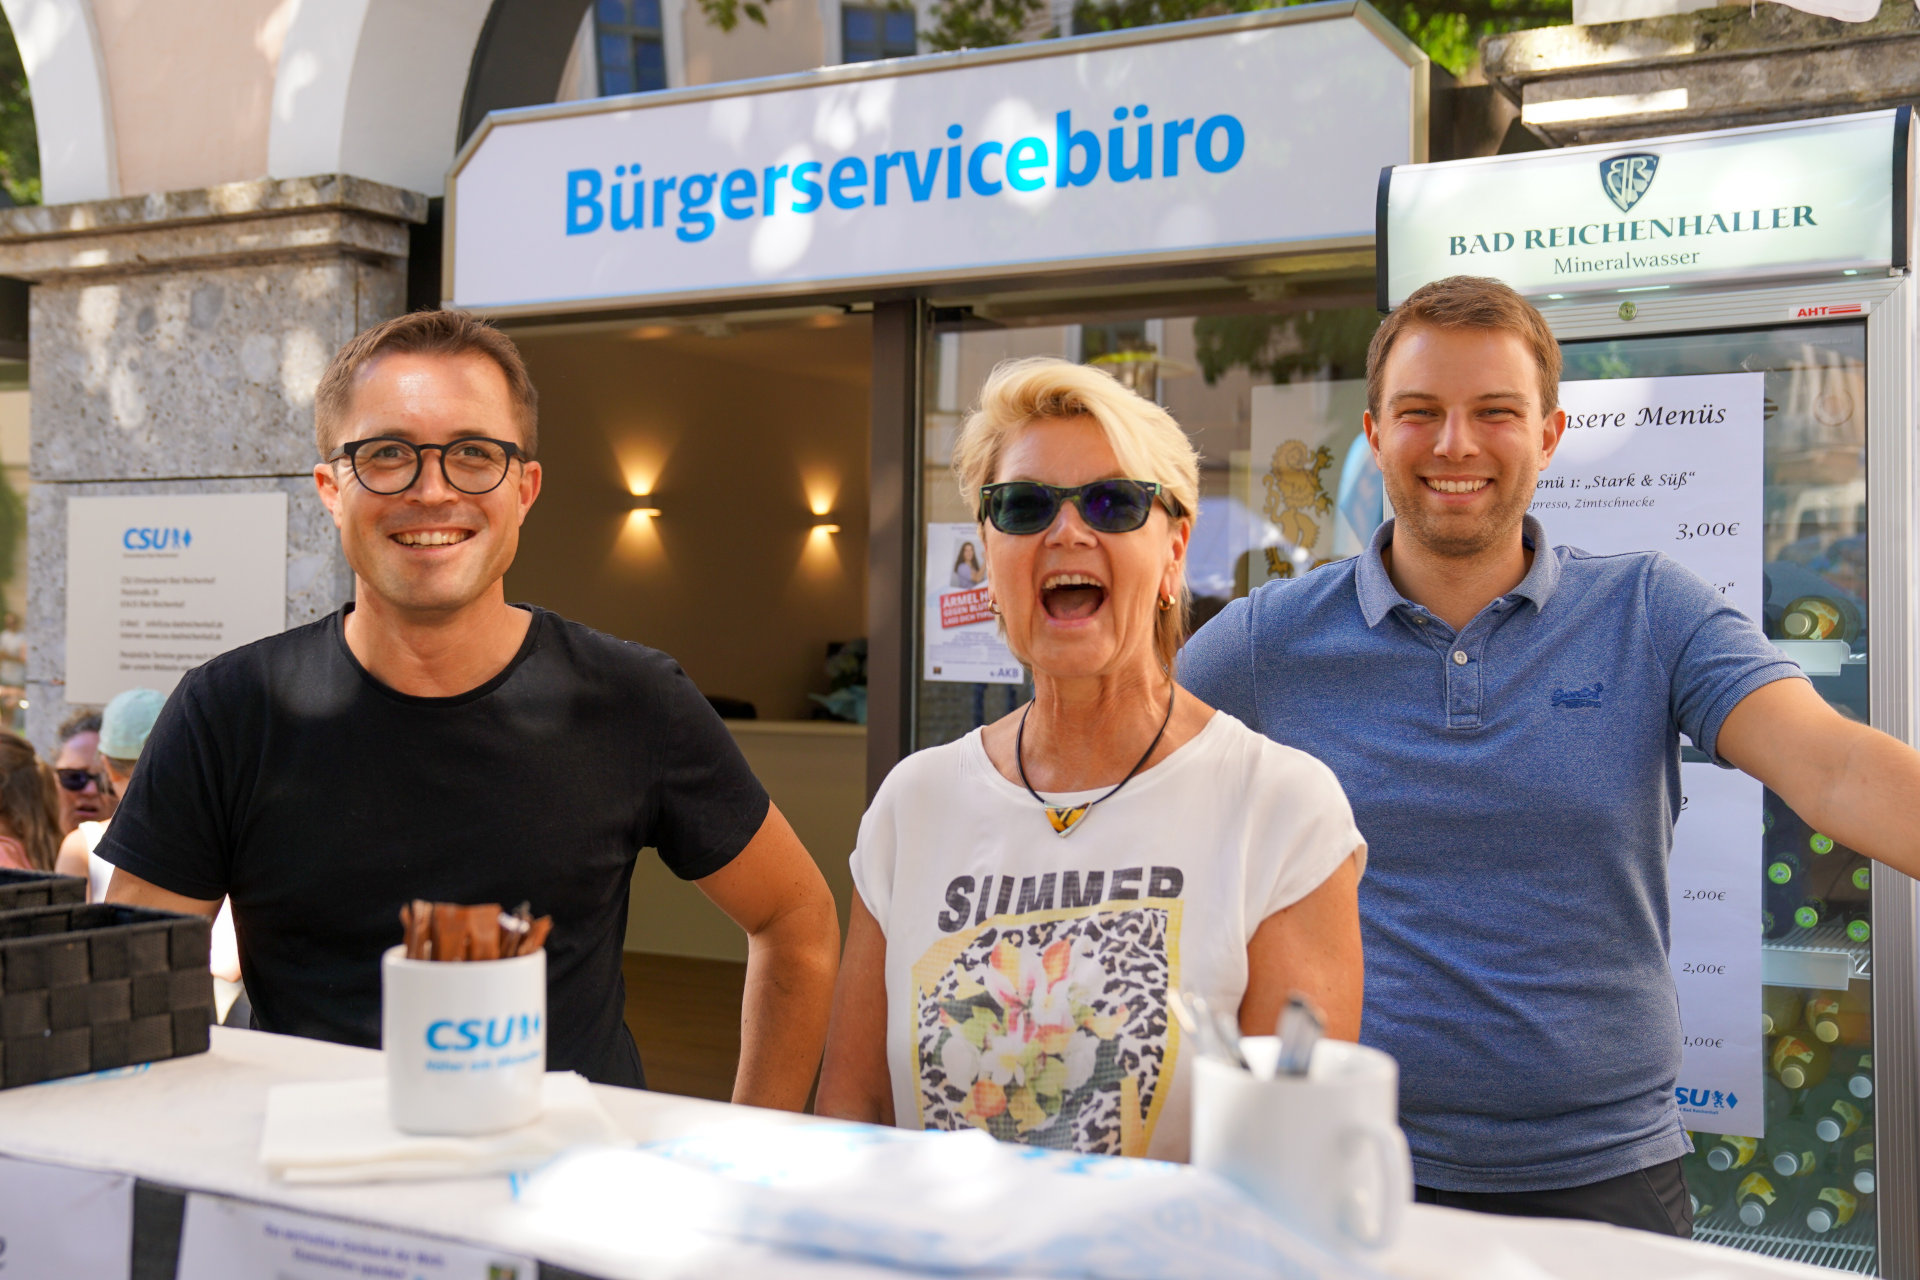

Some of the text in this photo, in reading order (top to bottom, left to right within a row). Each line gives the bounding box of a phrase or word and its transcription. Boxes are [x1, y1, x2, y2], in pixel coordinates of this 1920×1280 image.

[565, 104, 1246, 244] Bürgerservicebüro
[1449, 205, 1818, 256] BAD REICHENHALLER
[1553, 250, 1701, 276] Mineralwasser
[1797, 306, 1829, 318] AHT
[1566, 404, 1727, 430] nsere Menüs
[1536, 475, 1565, 489] enü
[1584, 472, 1636, 491] „Stark
[1640, 473, 1653, 487] &
[1530, 496, 1655, 513] presso, Zimtschnecke
[123, 528, 170, 550] CSU
[1675, 522, 1740, 541] 3,00€
[1683, 888, 1726, 902] 2,00€
[1683, 962, 1726, 975] 2,00€
[425, 1016, 515, 1052] CSU
[1683, 1036, 1724, 1049] 1,00€
[1675, 1087, 1710, 1106] SU
